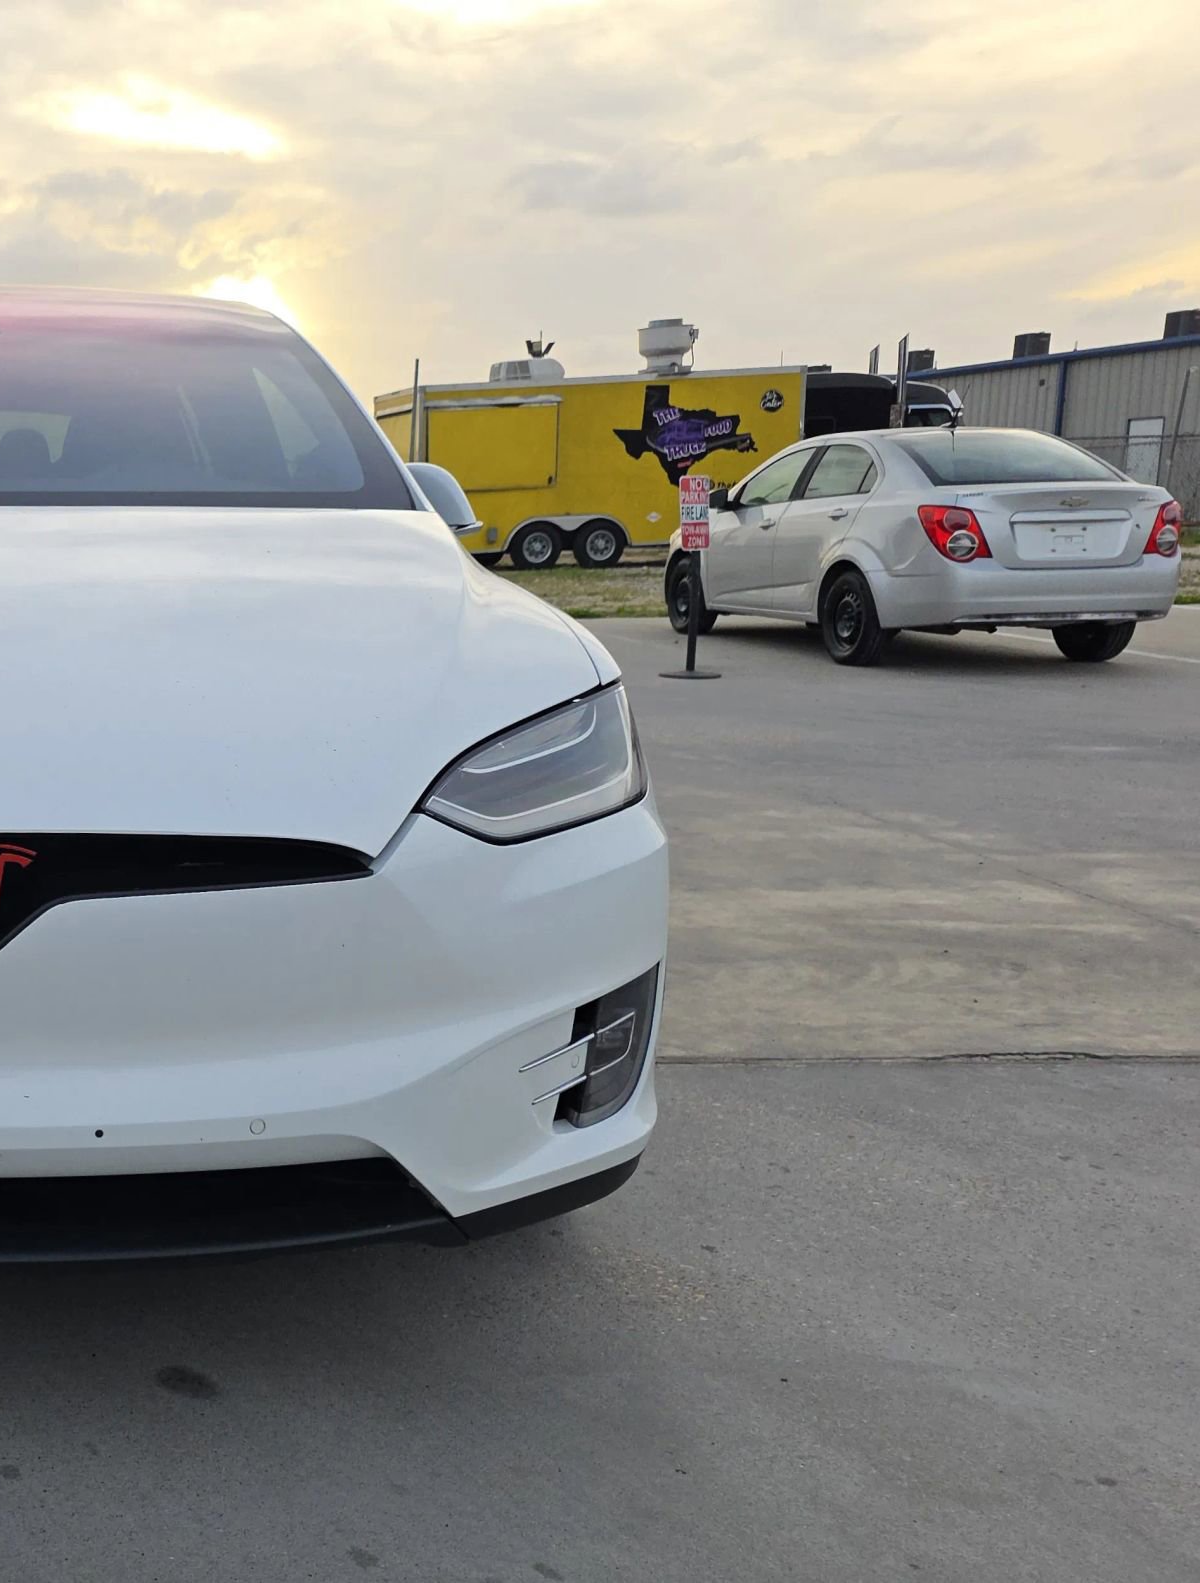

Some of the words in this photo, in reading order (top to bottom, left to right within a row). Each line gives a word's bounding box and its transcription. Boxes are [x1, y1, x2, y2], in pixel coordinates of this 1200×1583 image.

[690, 479, 703, 490] NO
[681, 506, 694, 520] FIRE
[695, 506, 709, 520] LANE
[688, 536, 706, 547] ZONE
